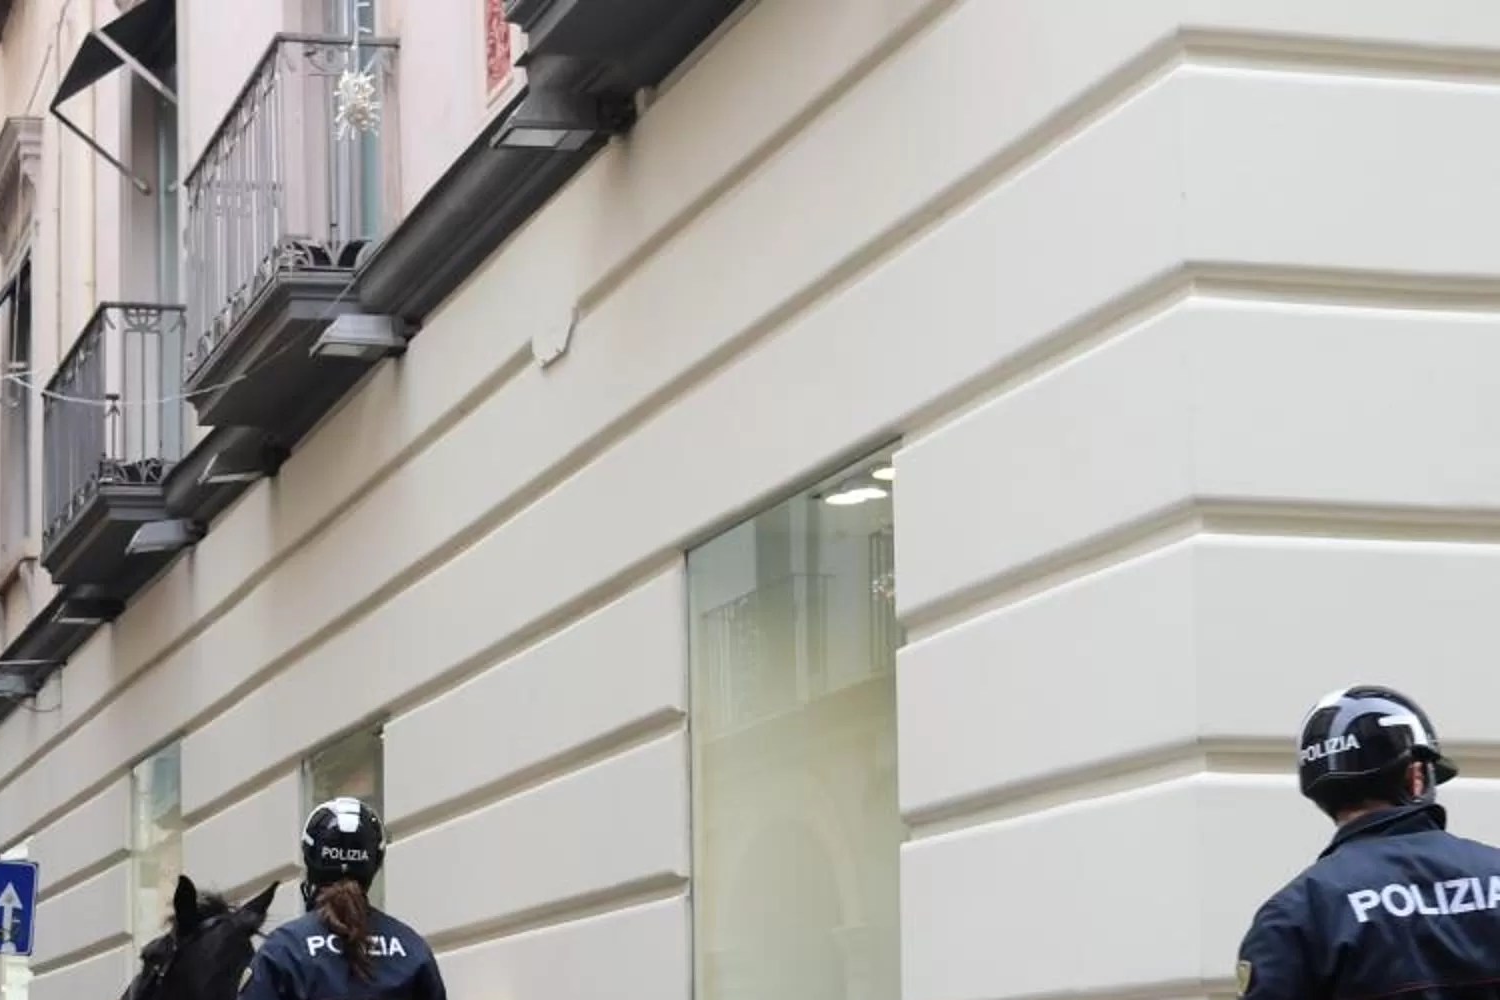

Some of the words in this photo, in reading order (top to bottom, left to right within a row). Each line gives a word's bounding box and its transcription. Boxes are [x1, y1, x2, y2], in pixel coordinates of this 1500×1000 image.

[1300, 734, 1361, 766] POLIZIA
[322, 847, 369, 860] POLIZIA
[306, 934, 407, 957] POZIA
